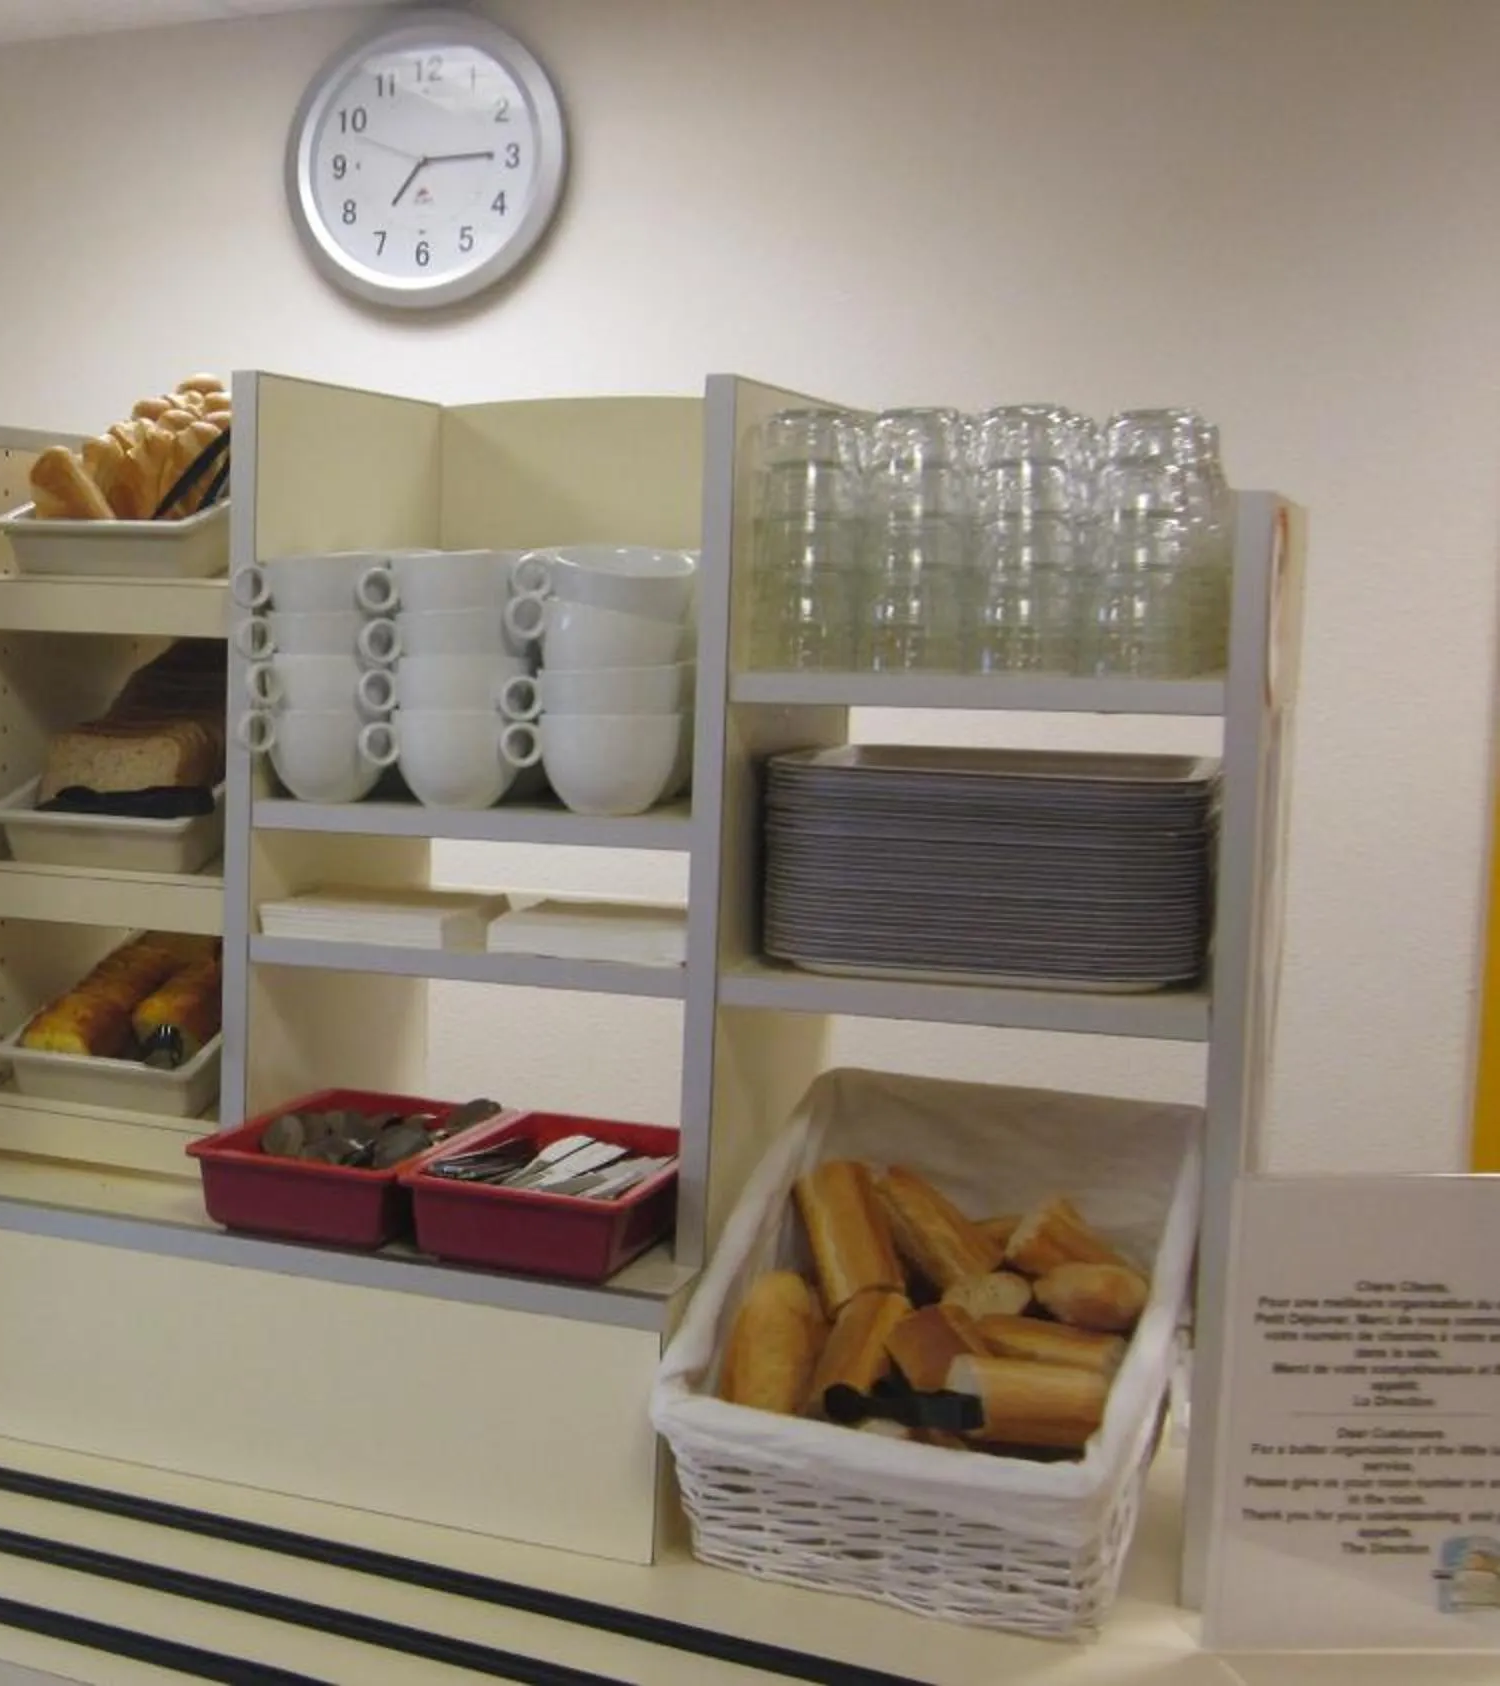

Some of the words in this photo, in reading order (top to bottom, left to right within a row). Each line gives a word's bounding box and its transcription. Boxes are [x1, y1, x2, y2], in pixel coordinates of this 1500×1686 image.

[414, 55, 444, 83] 12
[374, 73, 396, 98] 11
[338, 106, 368, 134] 10
[493, 100, 510, 124] 2
[331, 154, 347, 180] 9
[505, 143, 521, 169] 3
[341, 199, 357, 226] 8
[489, 190, 506, 217] 4
[372, 230, 387, 256] 7
[458, 226, 474, 252] 5
[415, 241, 430, 267] 6
